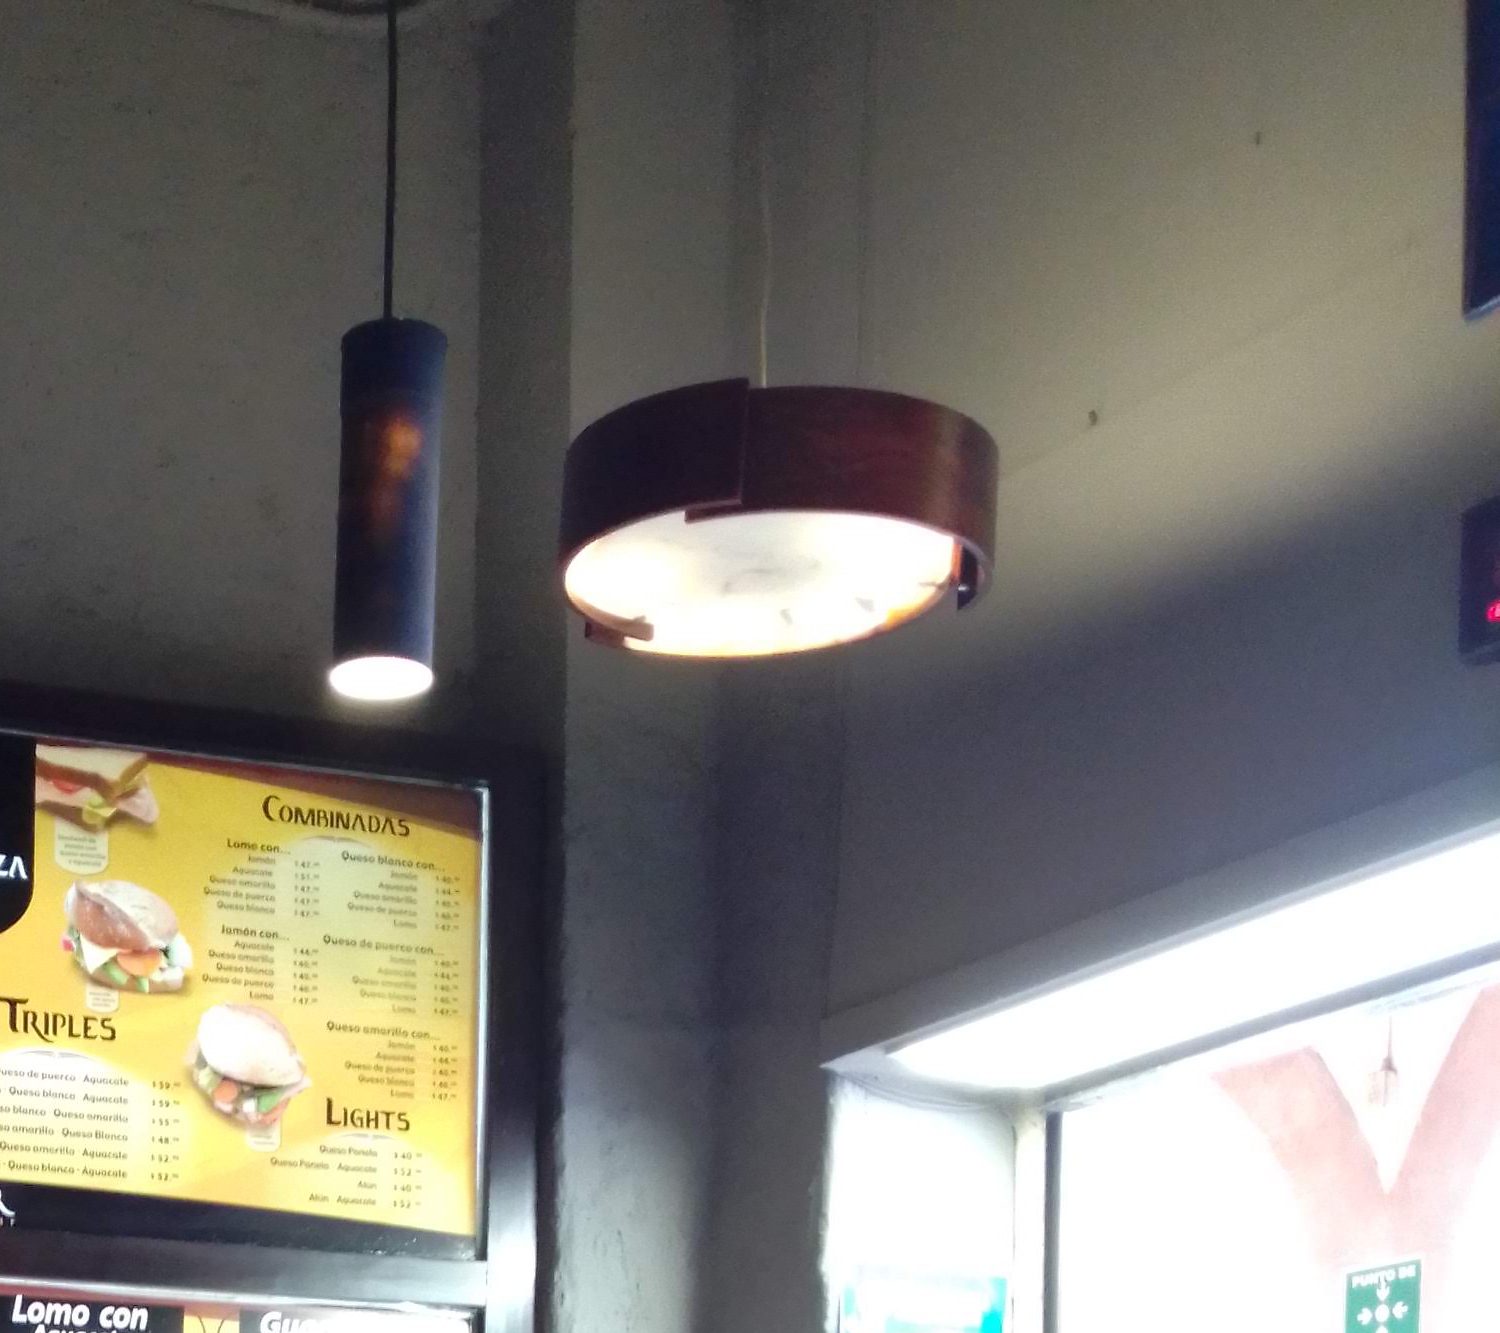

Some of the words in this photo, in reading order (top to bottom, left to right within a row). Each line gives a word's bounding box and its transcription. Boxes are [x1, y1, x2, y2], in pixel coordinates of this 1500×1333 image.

[227, 839, 258, 850] Lomo
[342, 850, 376, 864] Queso
[323, 935, 356, 947] Queso
[327, 1021, 360, 1033] Queso
[13, 1104, 46, 1117] blanco
[326, 1097, 410, 1132] LIGHTS
[12, 1295, 90, 1328] Lomo
[100, 1305, 148, 1331] con
